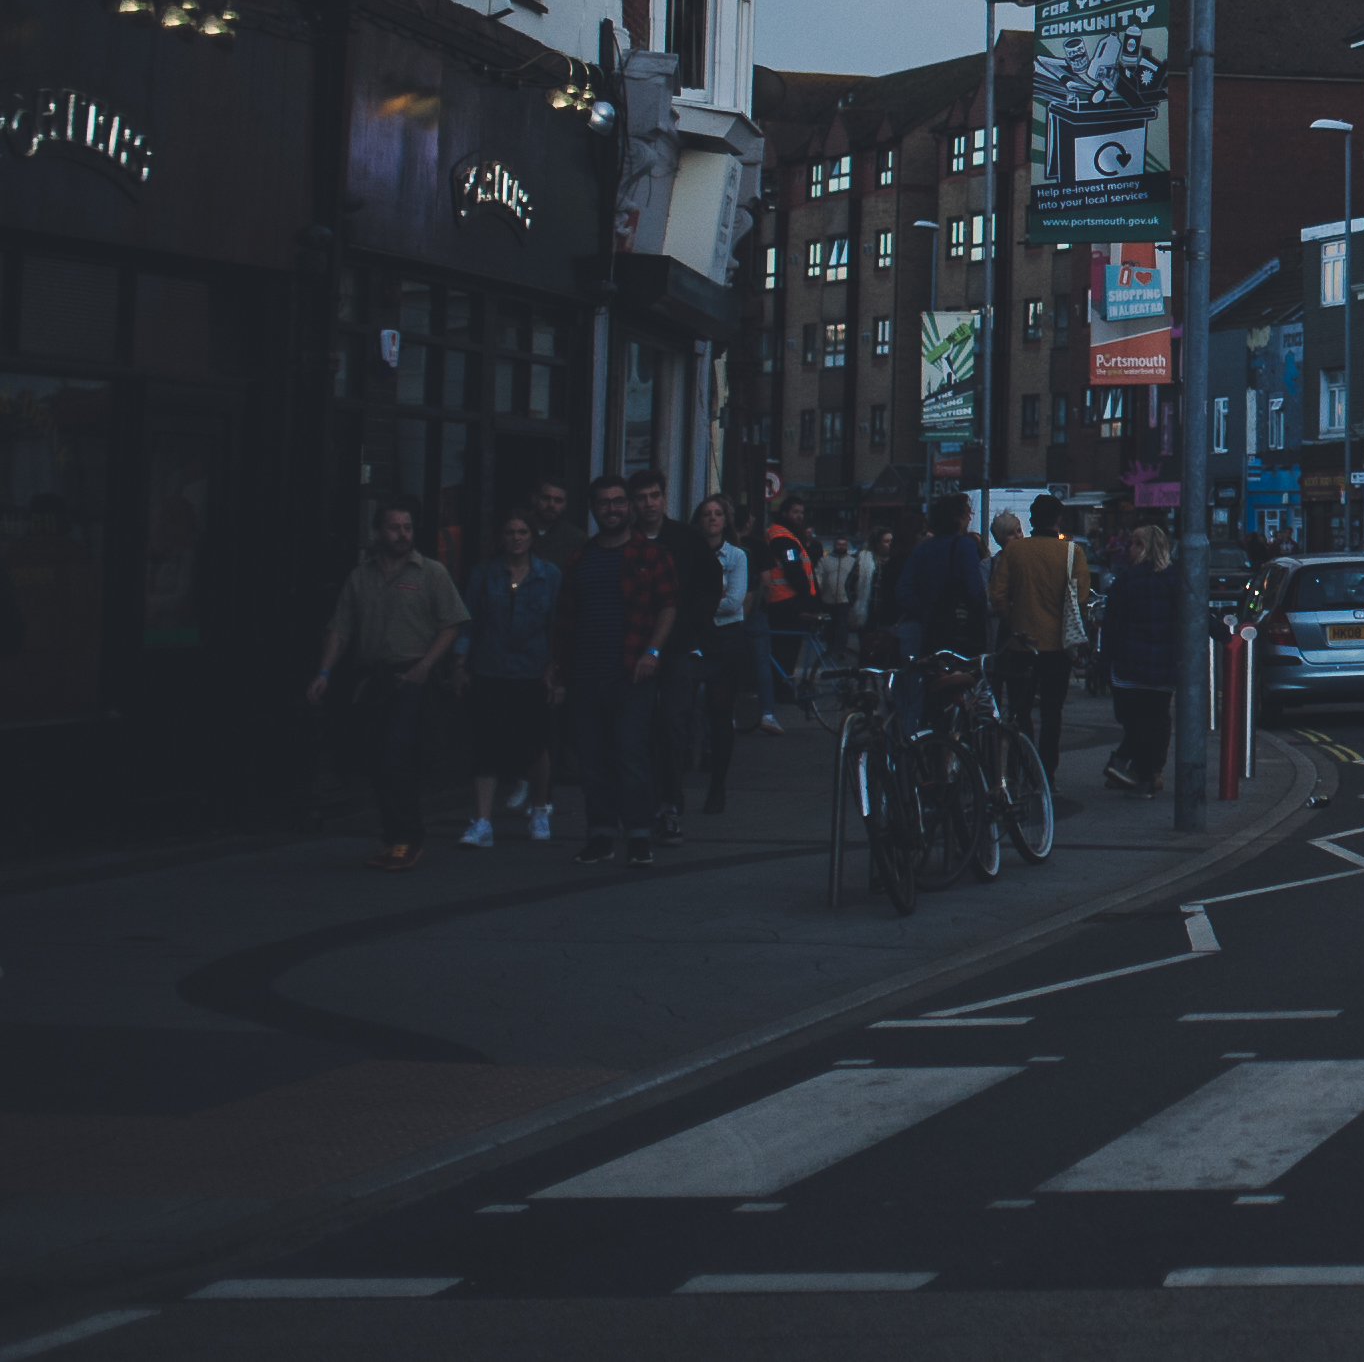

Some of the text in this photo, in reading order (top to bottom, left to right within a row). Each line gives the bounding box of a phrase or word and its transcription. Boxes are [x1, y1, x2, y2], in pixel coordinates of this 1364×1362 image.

[1042, 1, 1070, 18] FOR
[1041, 4, 1156, 36] COMMUNITY
[1037, 180, 1140, 198] Help re-invest money
[1038, 191, 1148, 210] into your local services
[1042, 216, 1159, 228] www.portsmouth.gov.uk
[1107, 288, 1161, 303] SHOPPING
[1109, 305, 1118, 318] IN
[1120, 303, 1150, 316] ALBERT
[1096, 353, 1166, 368] Portsmouth
[1332, 626, 1361, 639] HK08
